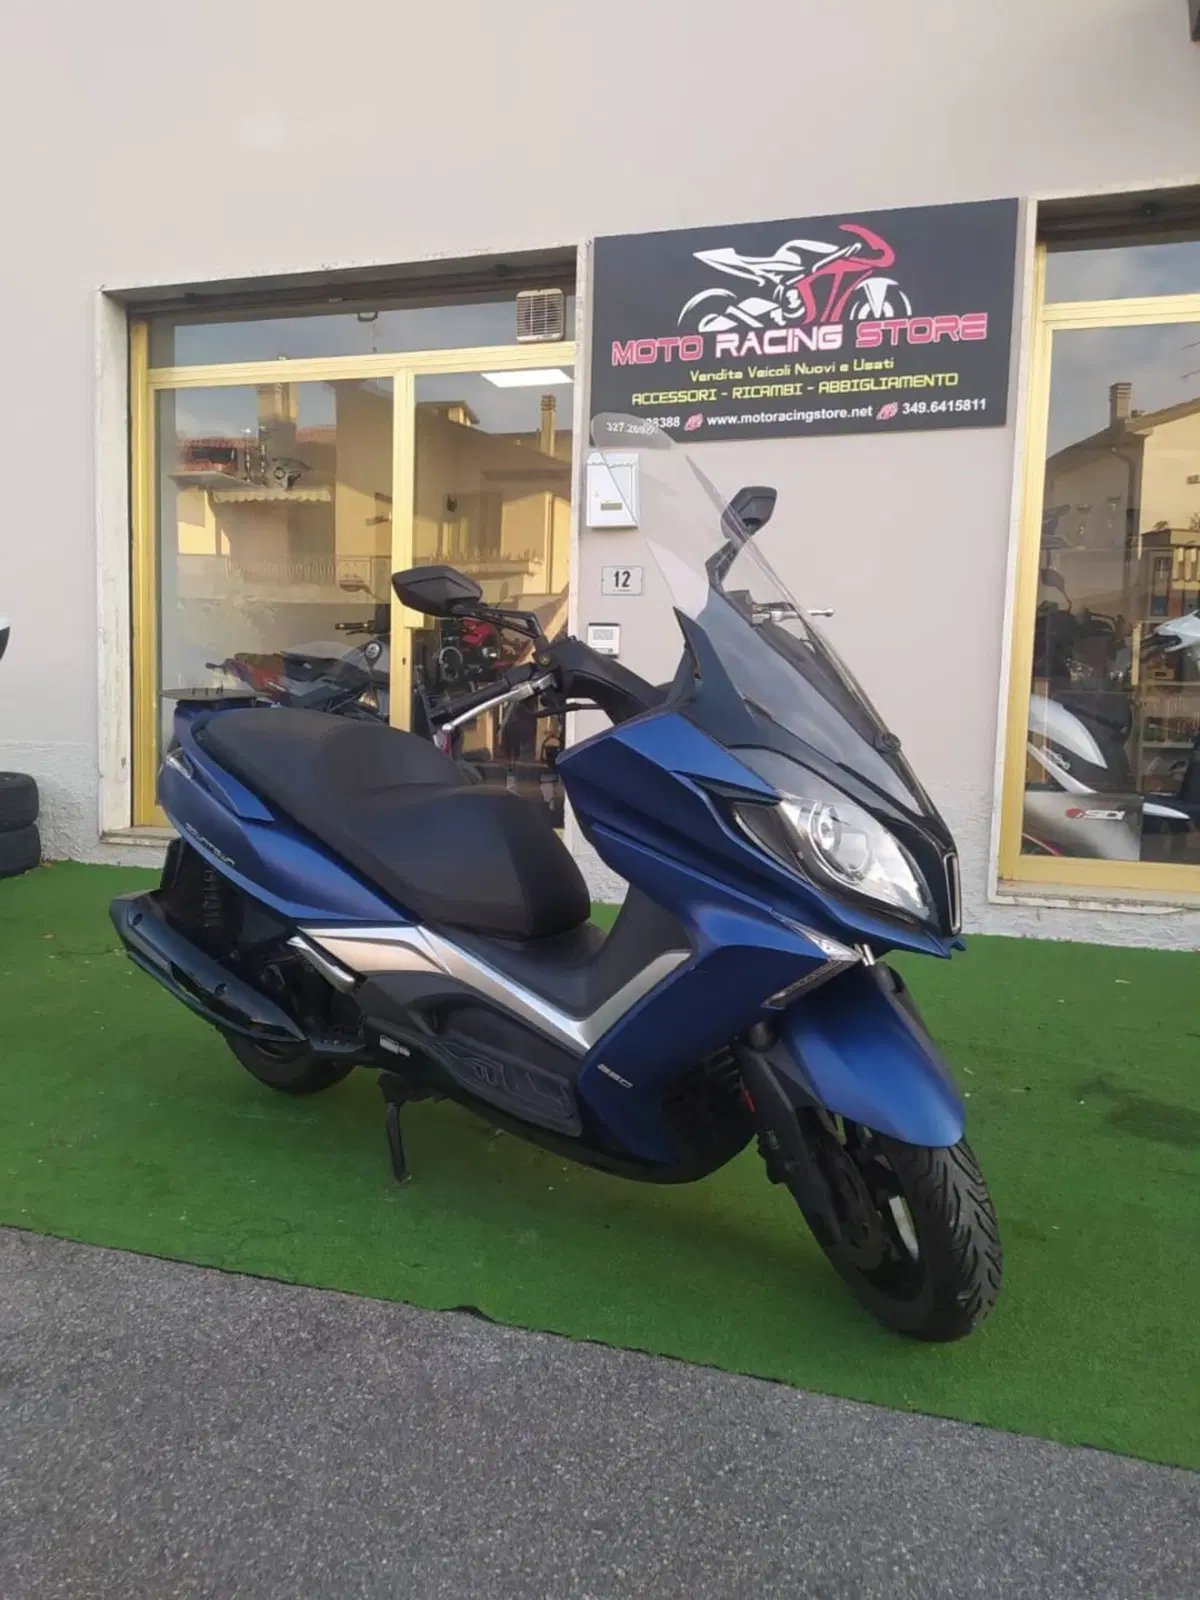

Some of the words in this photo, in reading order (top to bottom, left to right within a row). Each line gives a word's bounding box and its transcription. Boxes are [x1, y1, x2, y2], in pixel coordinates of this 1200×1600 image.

[612, 335, 704, 366] MOTO
[715, 324, 844, 358] RACING
[855, 312, 988, 348] STORE
[690, 369, 743, 382] Vendita
[748, 364, 791, 378] Veicoli
[794, 361, 836, 375] Nuovi
[840, 364, 849, 372] e
[853, 357, 894, 371] Usati
[632, 388, 717, 406] ACCESSORI
[732, 383, 803, 400] RICAMBI
[818, 372, 959, 395] ABBIGLIAMENTO
[706, 405, 873, 426] www.motoracingstore.net
[902, 398, 987, 415] 349.6415811
[614, 571, 631, 587] 12
